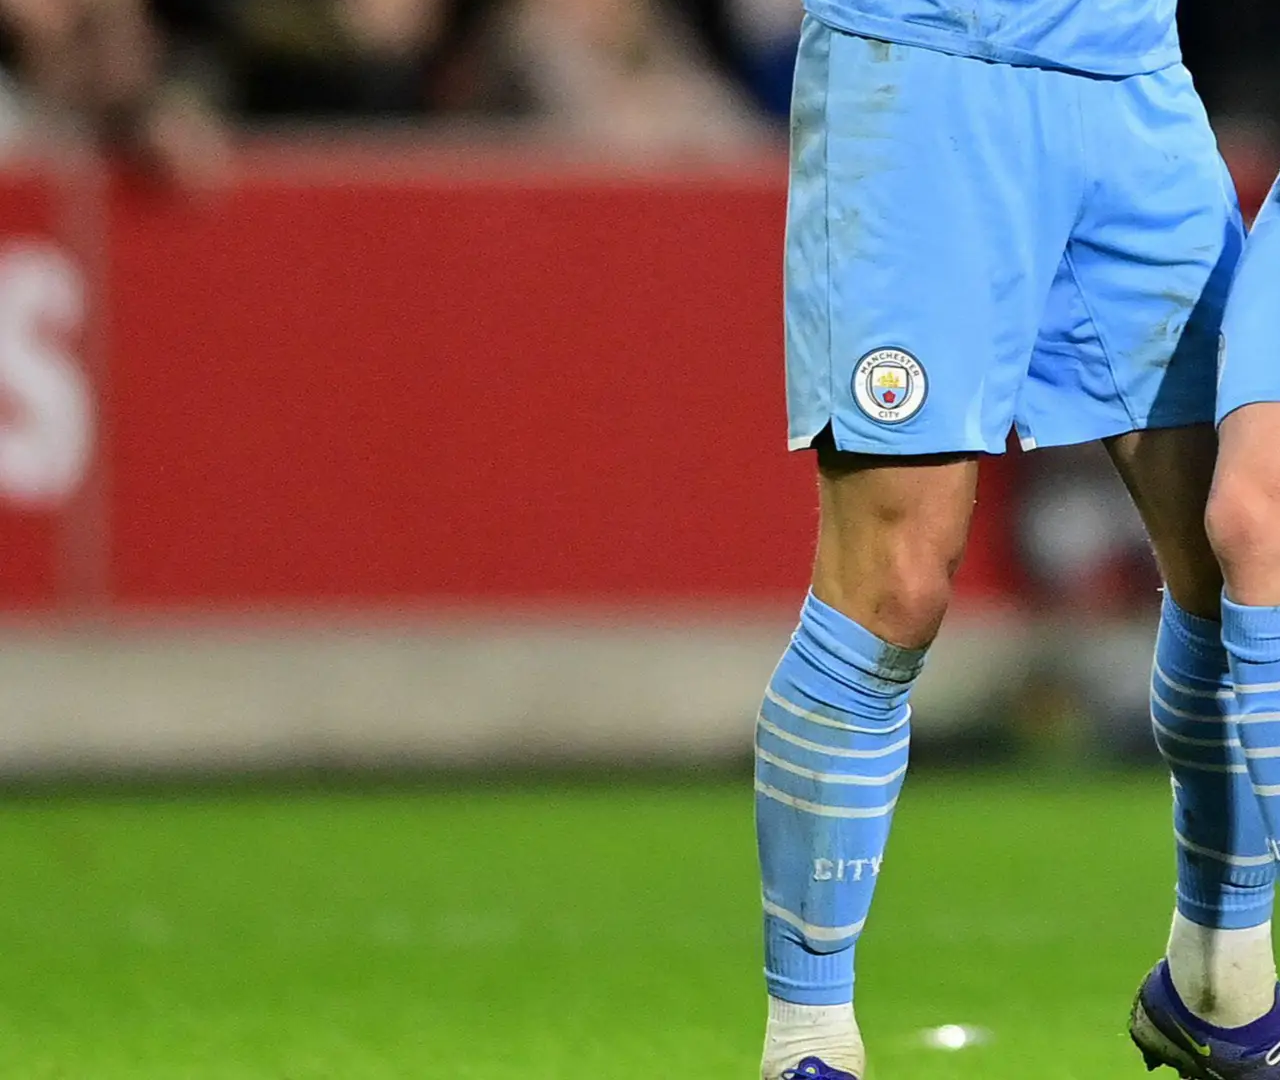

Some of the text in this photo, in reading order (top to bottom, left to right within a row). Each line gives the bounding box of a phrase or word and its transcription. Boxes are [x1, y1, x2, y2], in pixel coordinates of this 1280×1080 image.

[860, 351, 920, 377] MANCHESTER
[878, 410, 900, 419] CITY
[812, 853, 884, 883] CITY
